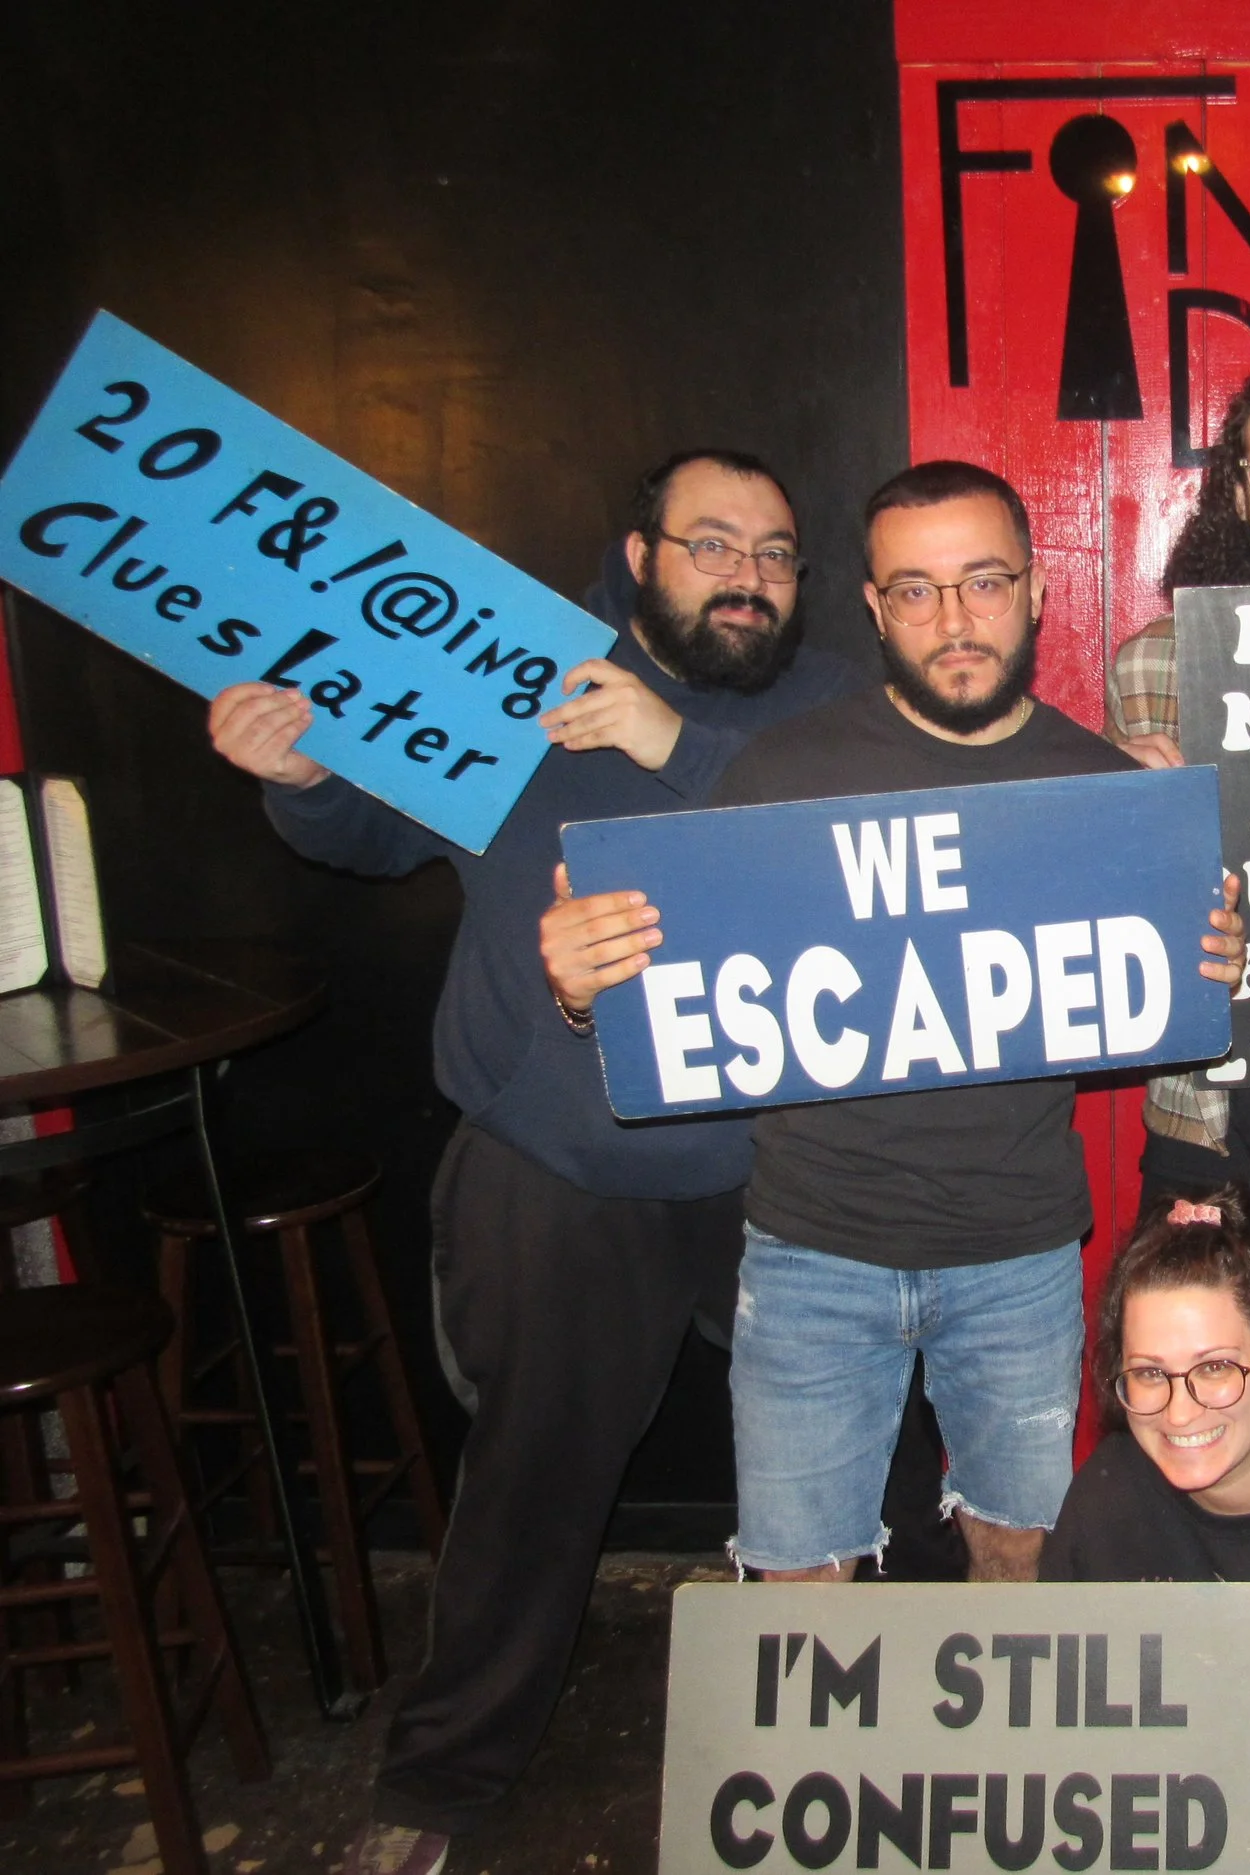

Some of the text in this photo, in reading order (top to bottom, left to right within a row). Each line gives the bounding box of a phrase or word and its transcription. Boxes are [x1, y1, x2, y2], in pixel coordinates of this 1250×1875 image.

[74, 380, 223, 480] 20
[18, 501, 499, 781] Clues Later
[831, 812, 968, 920] WE
[642, 915, 1171, 1104] ESCAPED
[754, 1632, 1188, 1730] I'M STILL
[710, 1770, 1229, 1873] CONFUSED
